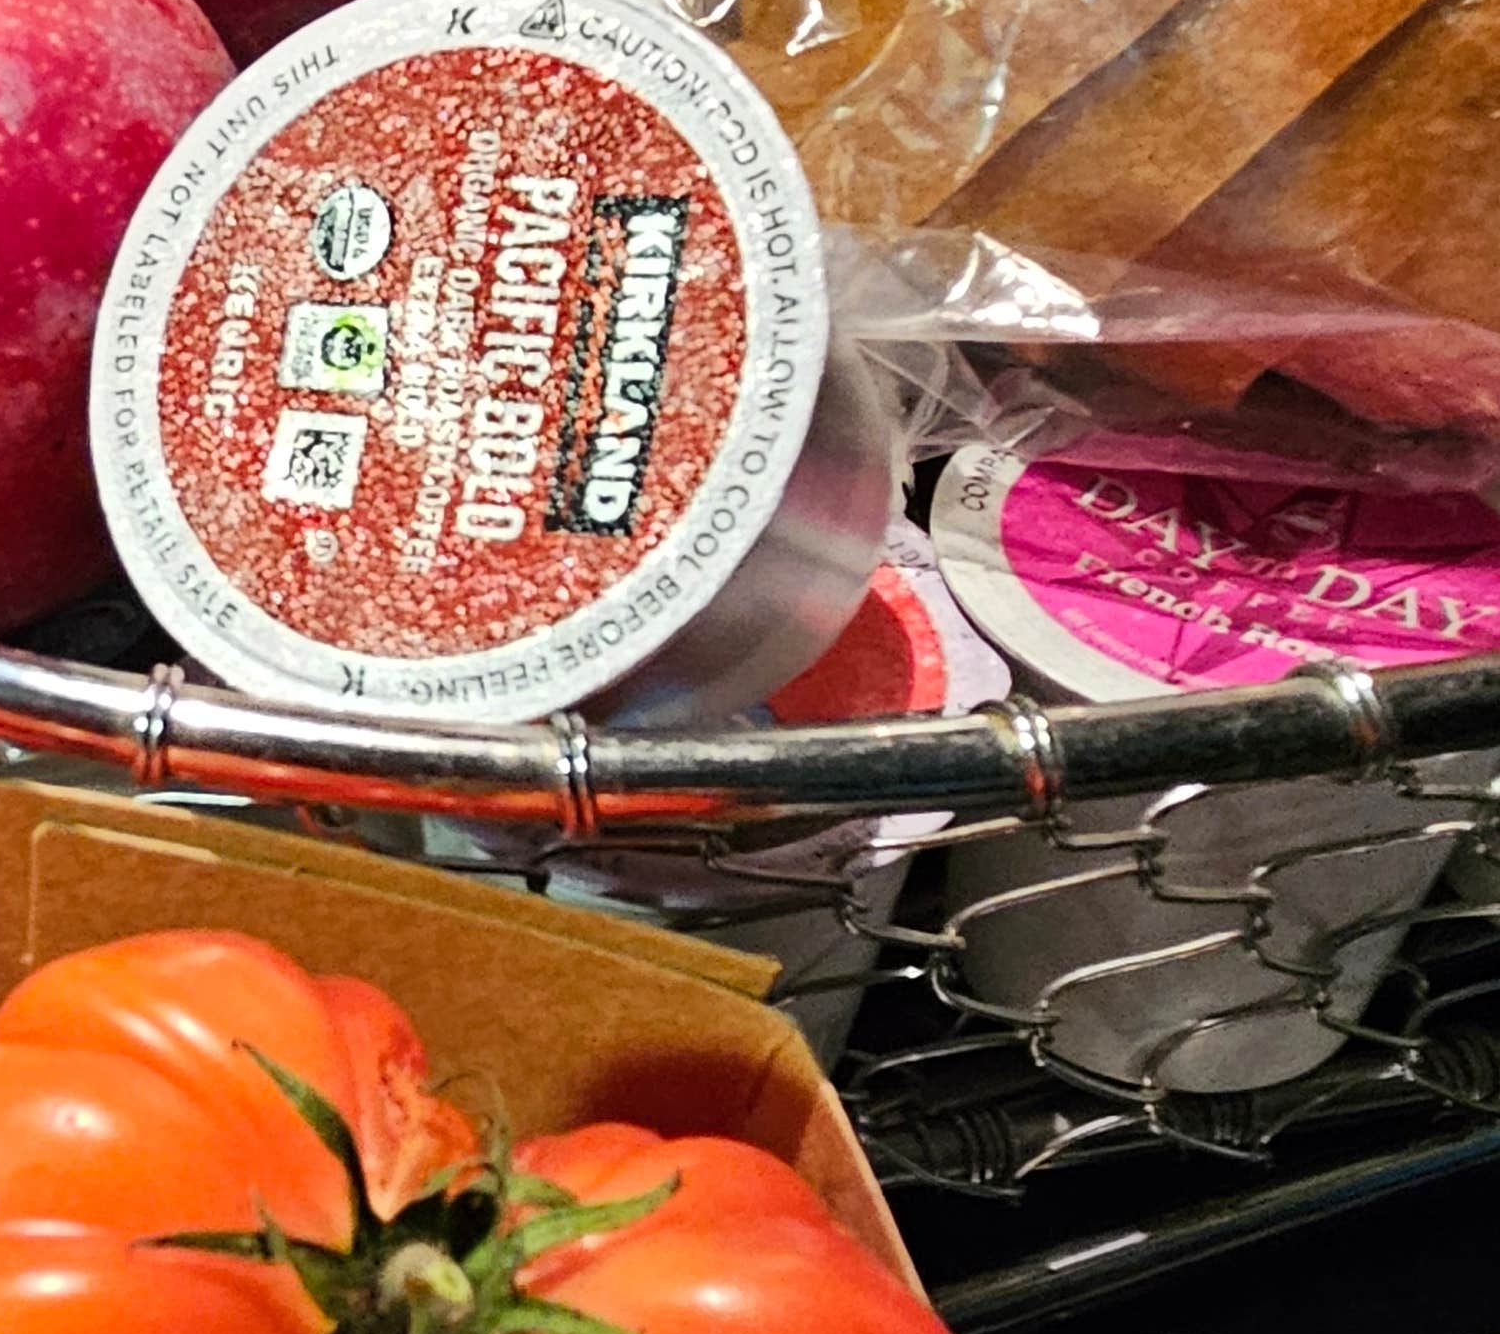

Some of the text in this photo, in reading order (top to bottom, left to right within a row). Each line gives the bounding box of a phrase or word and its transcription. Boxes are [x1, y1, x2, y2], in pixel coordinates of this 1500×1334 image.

[705, 100, 760, 167] POD
[746, 169, 778, 203] IS
[351, 206, 374, 261] USDA
[762, 206, 799, 285] HOT.
[113, 45, 340, 629] THIS UNIT NOT LABELED FOR RETAIL SALE
[394, 255, 444, 449] EXTRA BOLD
[397, 128, 500, 576] ORGANIC DARK ROAST COFFEE
[455, 174, 579, 542] PACIFIC BOLD
[581, 212, 678, 524] KIRKLAND
[760, 292, 799, 422] ALLOW
[740, 431, 779, 476] TO
[678, 484, 750, 571] COOL
[1072, 475, 1249, 572] DAY
[1303, 564, 1499, 639] DAY
[556, 573, 682, 664] BEFORE
[1072, 550, 1233, 634] French
[1133, 548, 1353, 634] COFFEE
